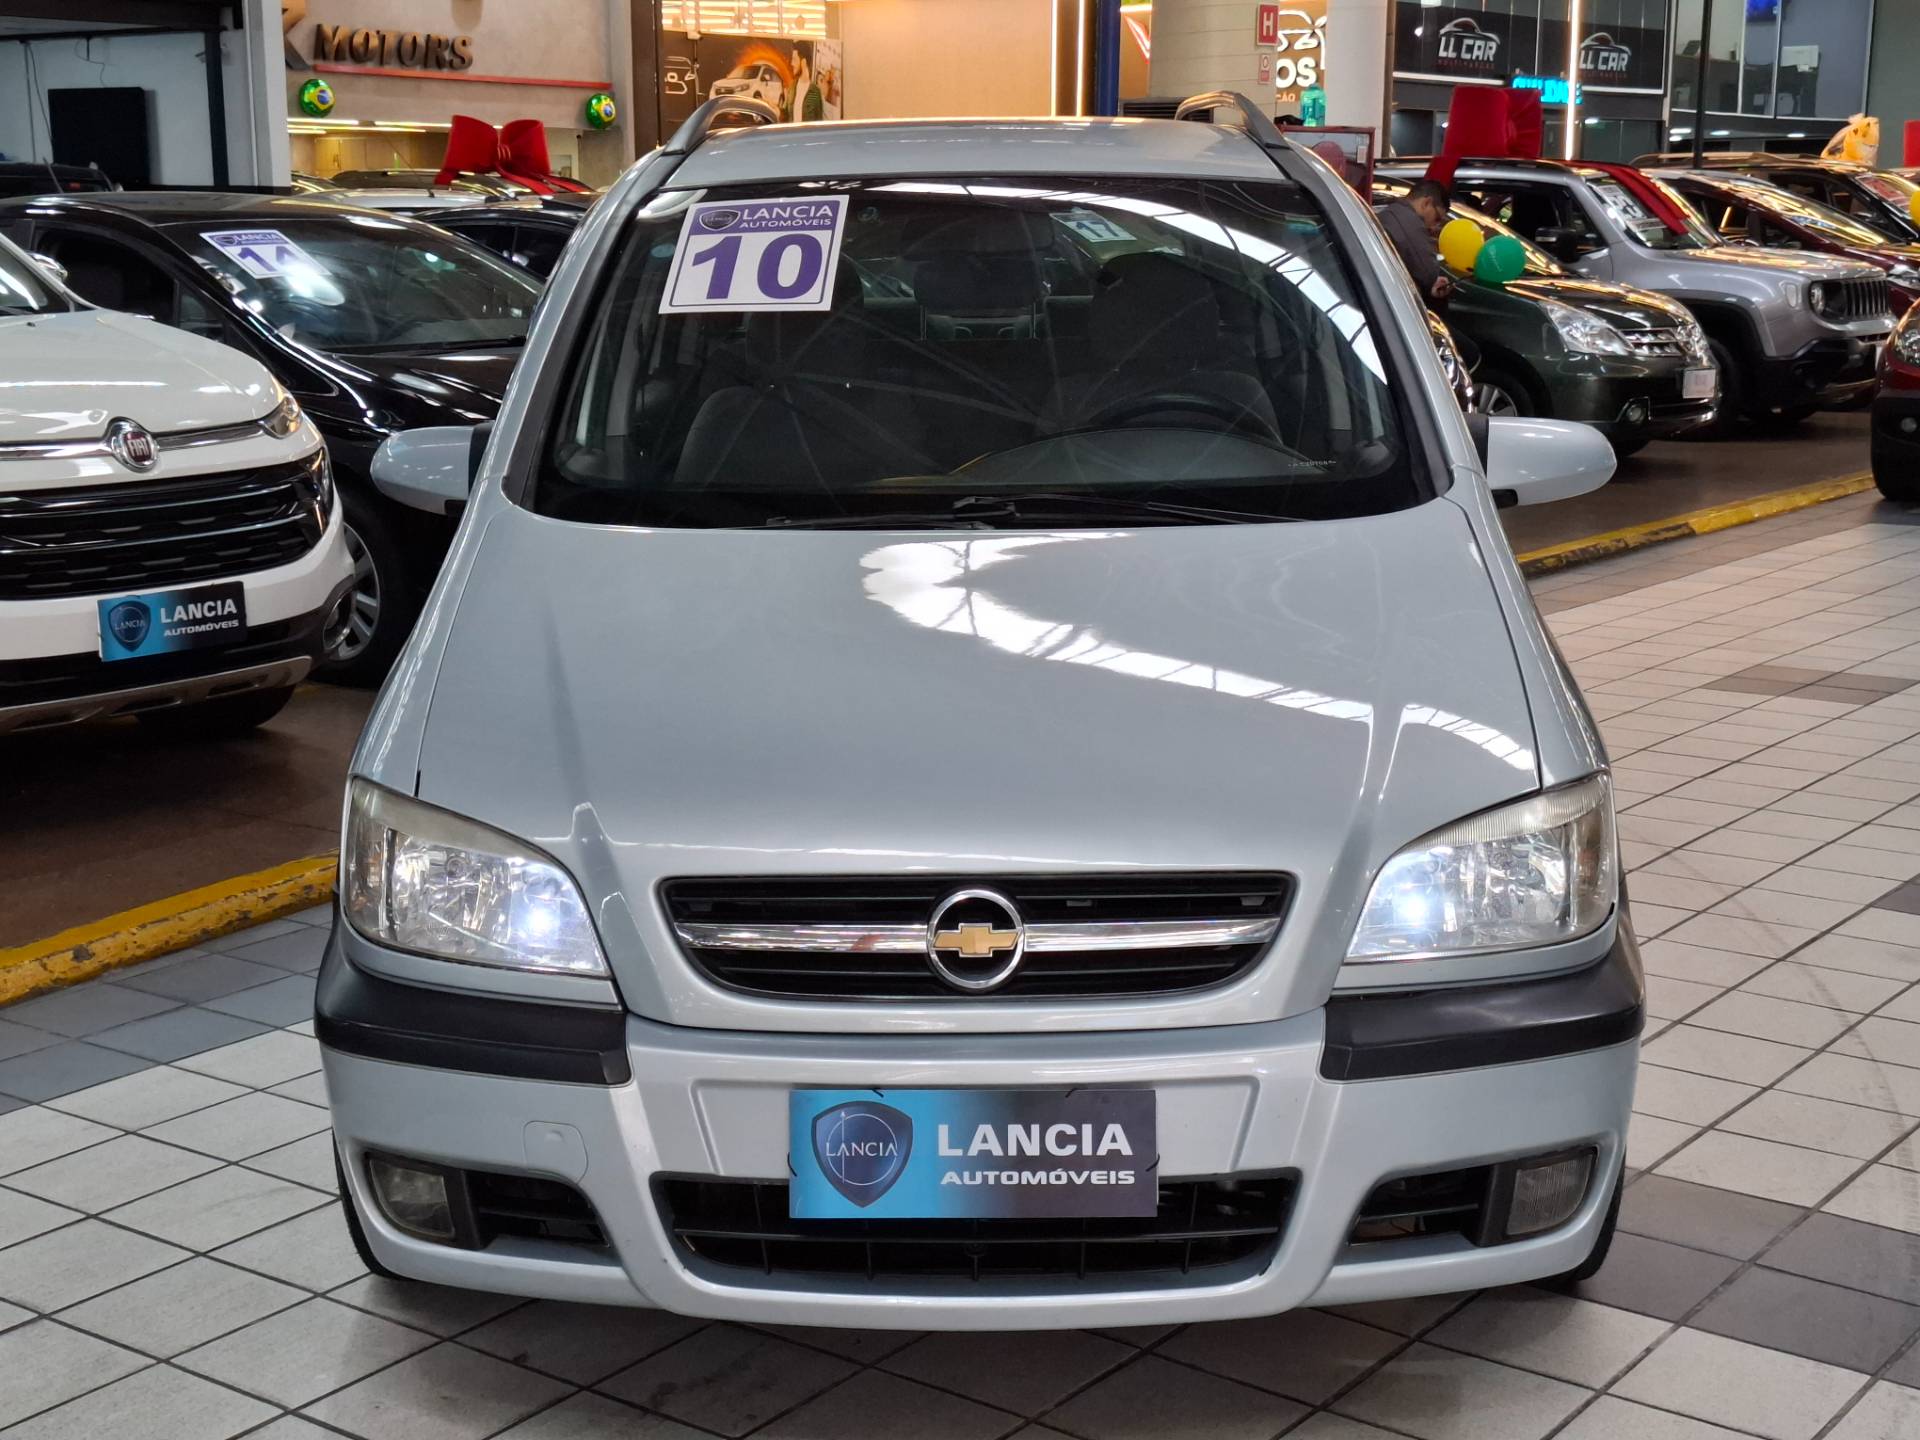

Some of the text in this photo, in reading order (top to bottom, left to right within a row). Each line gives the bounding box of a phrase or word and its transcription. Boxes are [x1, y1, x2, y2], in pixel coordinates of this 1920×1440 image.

[1263, 12, 1274, 37] H
[313, 24, 473, 70] MOTORS
[1438, 36, 1497, 61] LL CAR
[1579, 50, 1629, 71] LL CAR
[742, 205, 833, 220] LANCIA
[739, 218, 832, 229] AUTOMÓVEIS
[1076, 221, 1120, 238] 17
[692, 233, 823, 300] 10
[127, 437, 150, 457] FIAT
[160, 598, 238, 623] LANCIA
[114, 618, 146, 631] LANCIA
[163, 619, 240, 637] AUTOMÓVEIS
[826, 1141, 898, 1158] LANCIA
[938, 1123, 1133, 1157] LANCIA
[940, 1168, 1136, 1186] AUTOMÓVEIS
